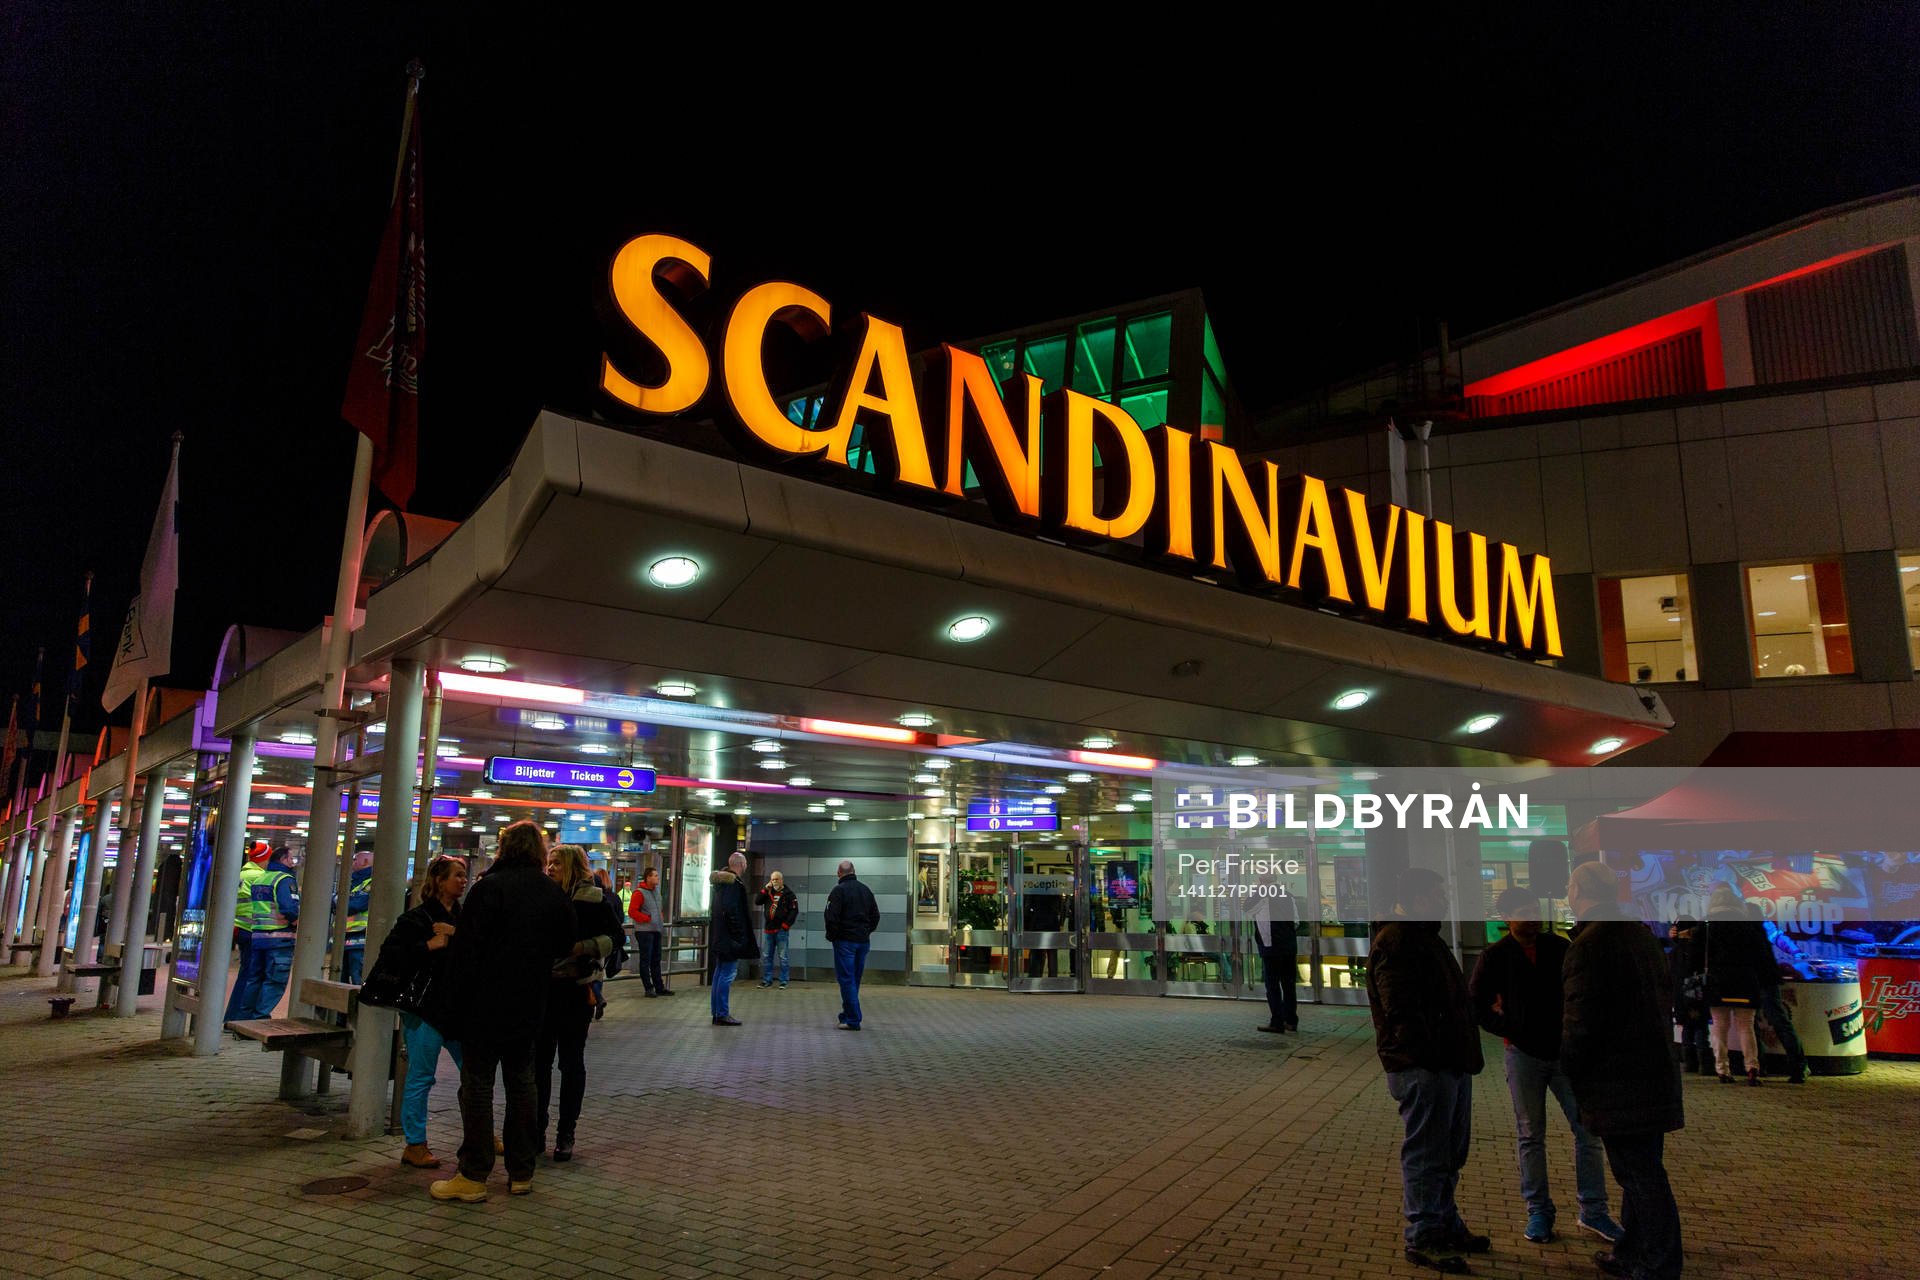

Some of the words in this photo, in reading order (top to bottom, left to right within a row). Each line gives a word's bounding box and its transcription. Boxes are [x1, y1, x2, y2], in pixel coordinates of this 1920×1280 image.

[601, 233, 1565, 658] SCANDINAVIUM
[514, 765, 556, 780] Biljetter
[570, 769, 605, 783] Tickets
[1775, 893, 1844, 936] KÖP
